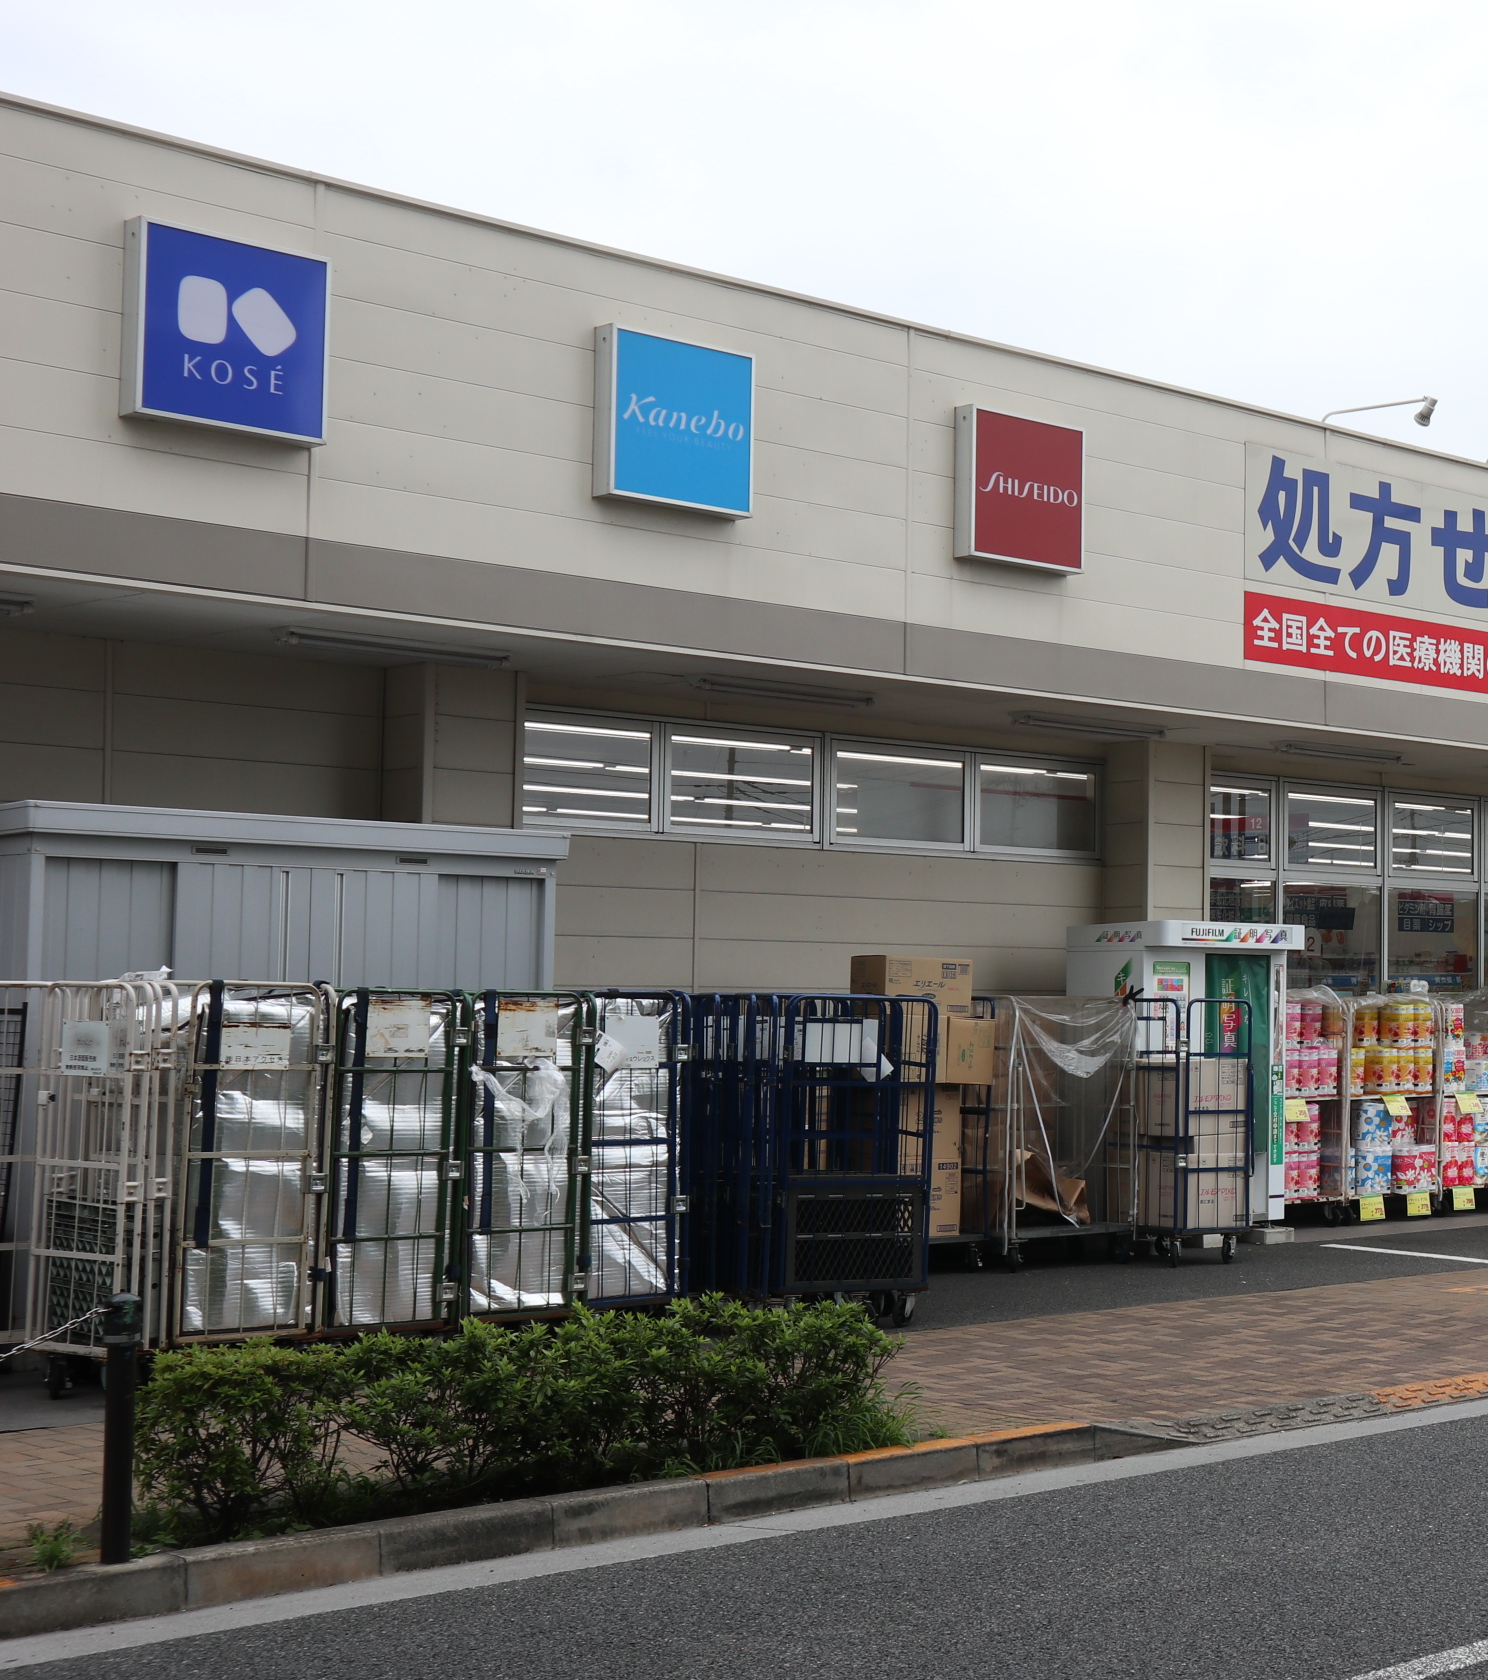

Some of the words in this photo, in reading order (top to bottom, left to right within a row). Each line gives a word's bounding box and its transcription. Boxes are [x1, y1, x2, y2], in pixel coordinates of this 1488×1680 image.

[182, 353, 285, 395] KOSÉ
[622, 393, 744, 441] Kanebo
[636, 427, 658, 438] FEEL
[663, 432, 688, 443] YOUR
[694, 438, 732, 450] BEAUTY
[979, 471, 1078, 507] SHISEIDO
[1250, 817, 1262, 830] 12
[1102, 930, 1143, 940] 証明写真
[1191, 928, 1225, 937] FUJIFILM
[1234, 928, 1288, 941] 証明写真
[913, 980, 946, 989] エリエール
